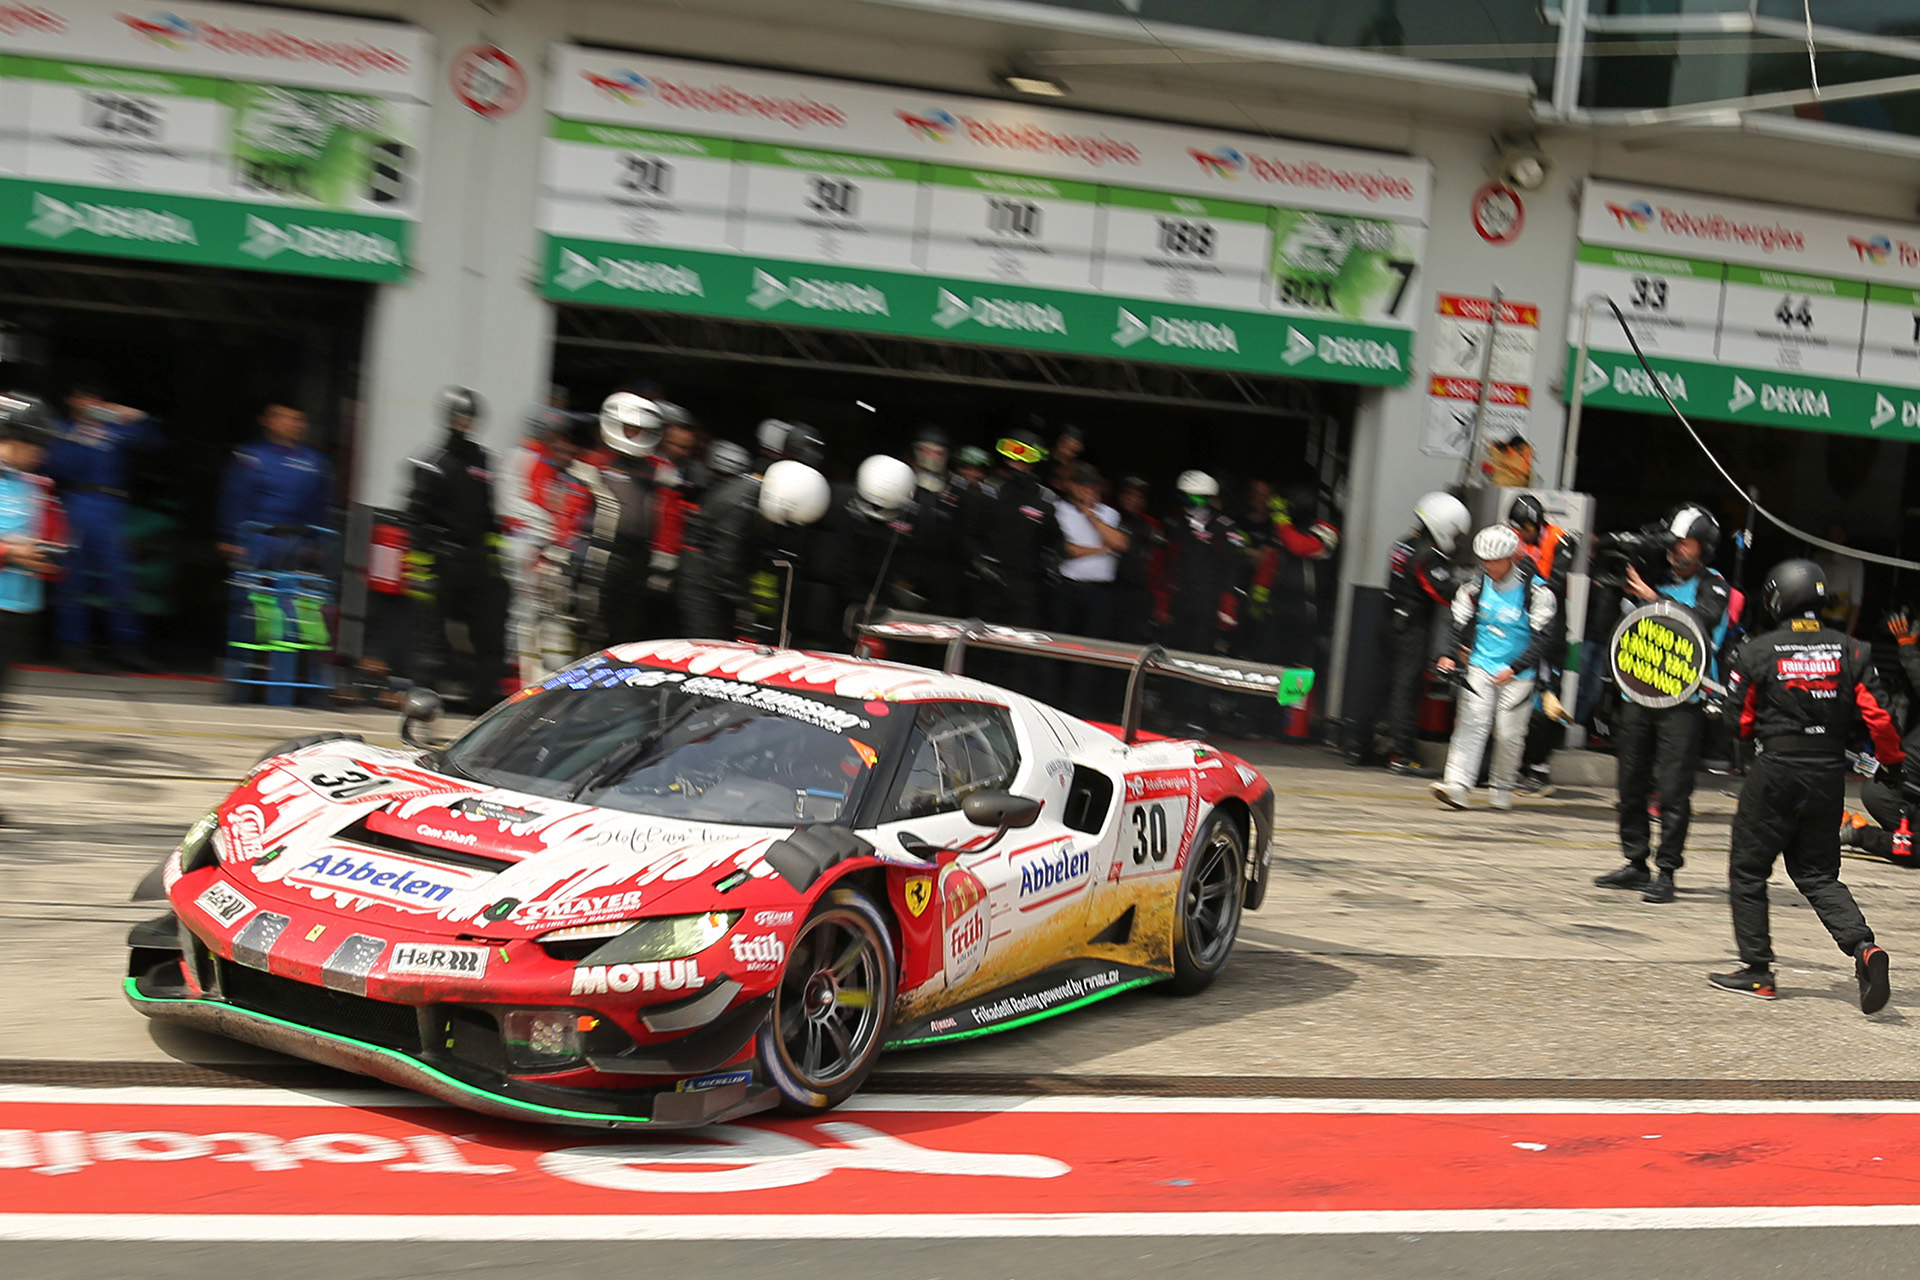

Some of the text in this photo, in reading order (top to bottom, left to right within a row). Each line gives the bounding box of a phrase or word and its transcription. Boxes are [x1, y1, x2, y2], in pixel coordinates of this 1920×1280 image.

[957, 117, 1142, 166] TotalEnergies
[1248, 152, 1414, 201] TotalEnergies
[1658, 206, 1806, 254] TotalEnergies
[600, 257, 704, 297] DEKRA
[789, 276, 889, 316] DEKRA
[1387, 259, 1419, 316] 7
[1630, 276, 1668, 311] 33
[972, 296, 1067, 335] DEKRA
[1774, 292, 1813, 331] 44
[1151, 315, 1239, 354] DEKRA
[1318, 334, 1401, 371] DEKRA
[1760, 383, 1831, 419] DEKRA
[417, 824, 478, 846] Cam Shaft
[1132, 804, 1167, 865] 30
[299, 854, 454, 902] Abbelen
[1019, 850, 1089, 898] Abbelen
[951, 909, 983, 958] früh
[396, 947, 447, 967] H&R
[570, 958, 706, 996] MOTUL
[971, 1000, 1014, 1024] Frikadelli
[1012, 993, 1043, 1014] Racing
[1040, 983, 1072, 1008] powered
[1070, 979, 1085, 996] by
